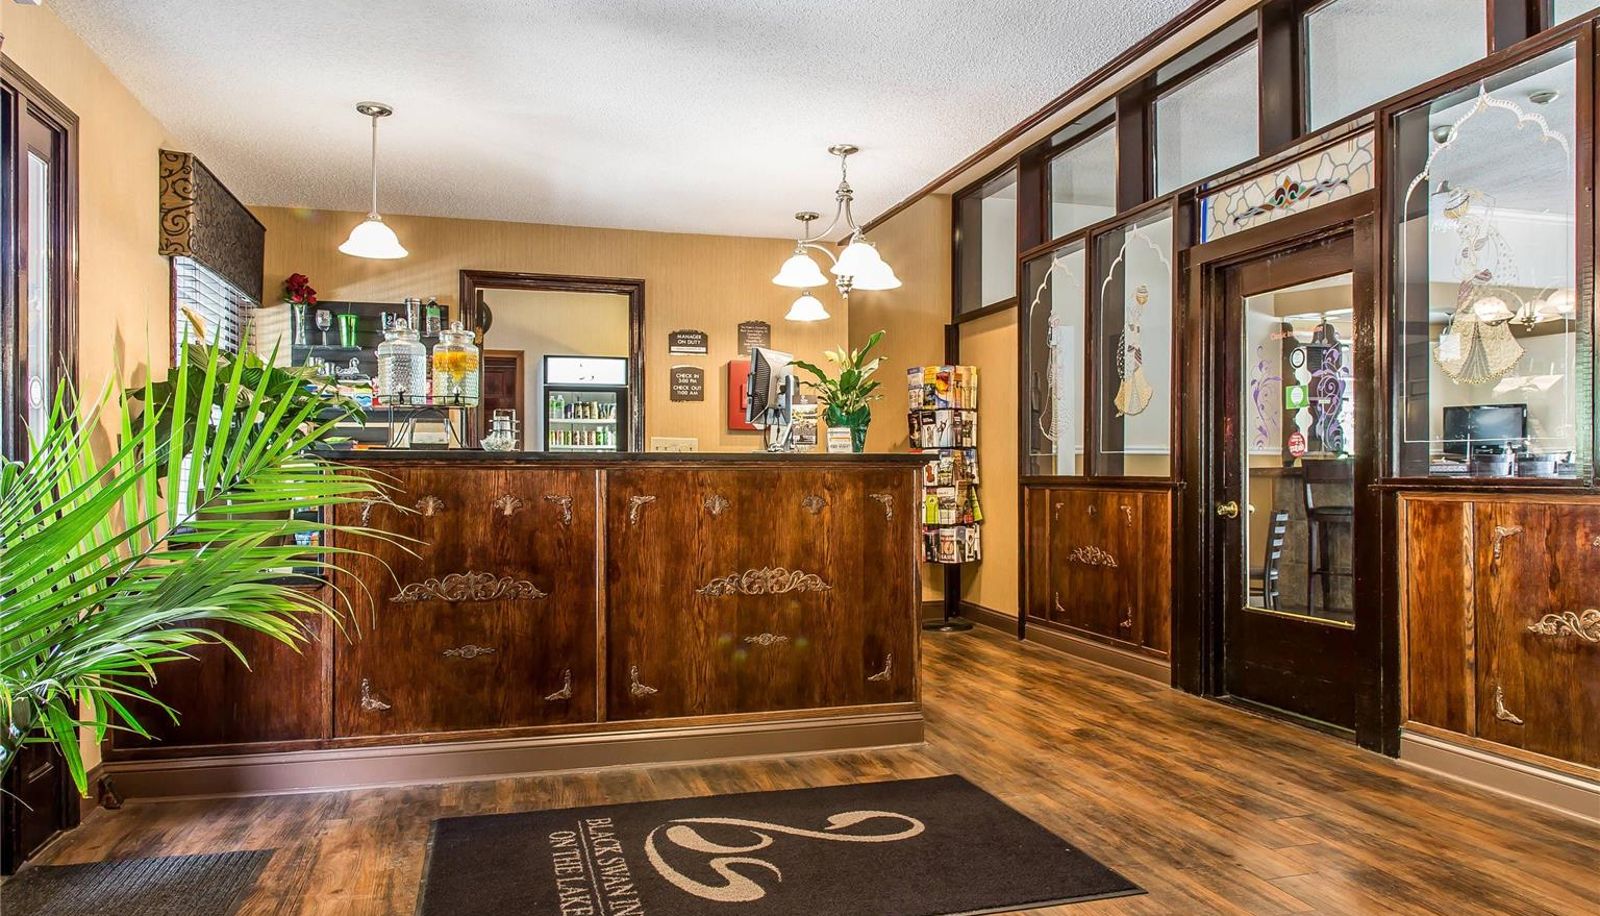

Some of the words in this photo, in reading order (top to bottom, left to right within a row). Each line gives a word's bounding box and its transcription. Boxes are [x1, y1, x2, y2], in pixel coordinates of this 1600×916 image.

[549, 831, 578, 848] ON
[585, 817, 623, 857] BLACK
[552, 848, 583, 876] THE
[597, 857, 638, 897] SWAN
[556, 876, 593, 916] LAKE
